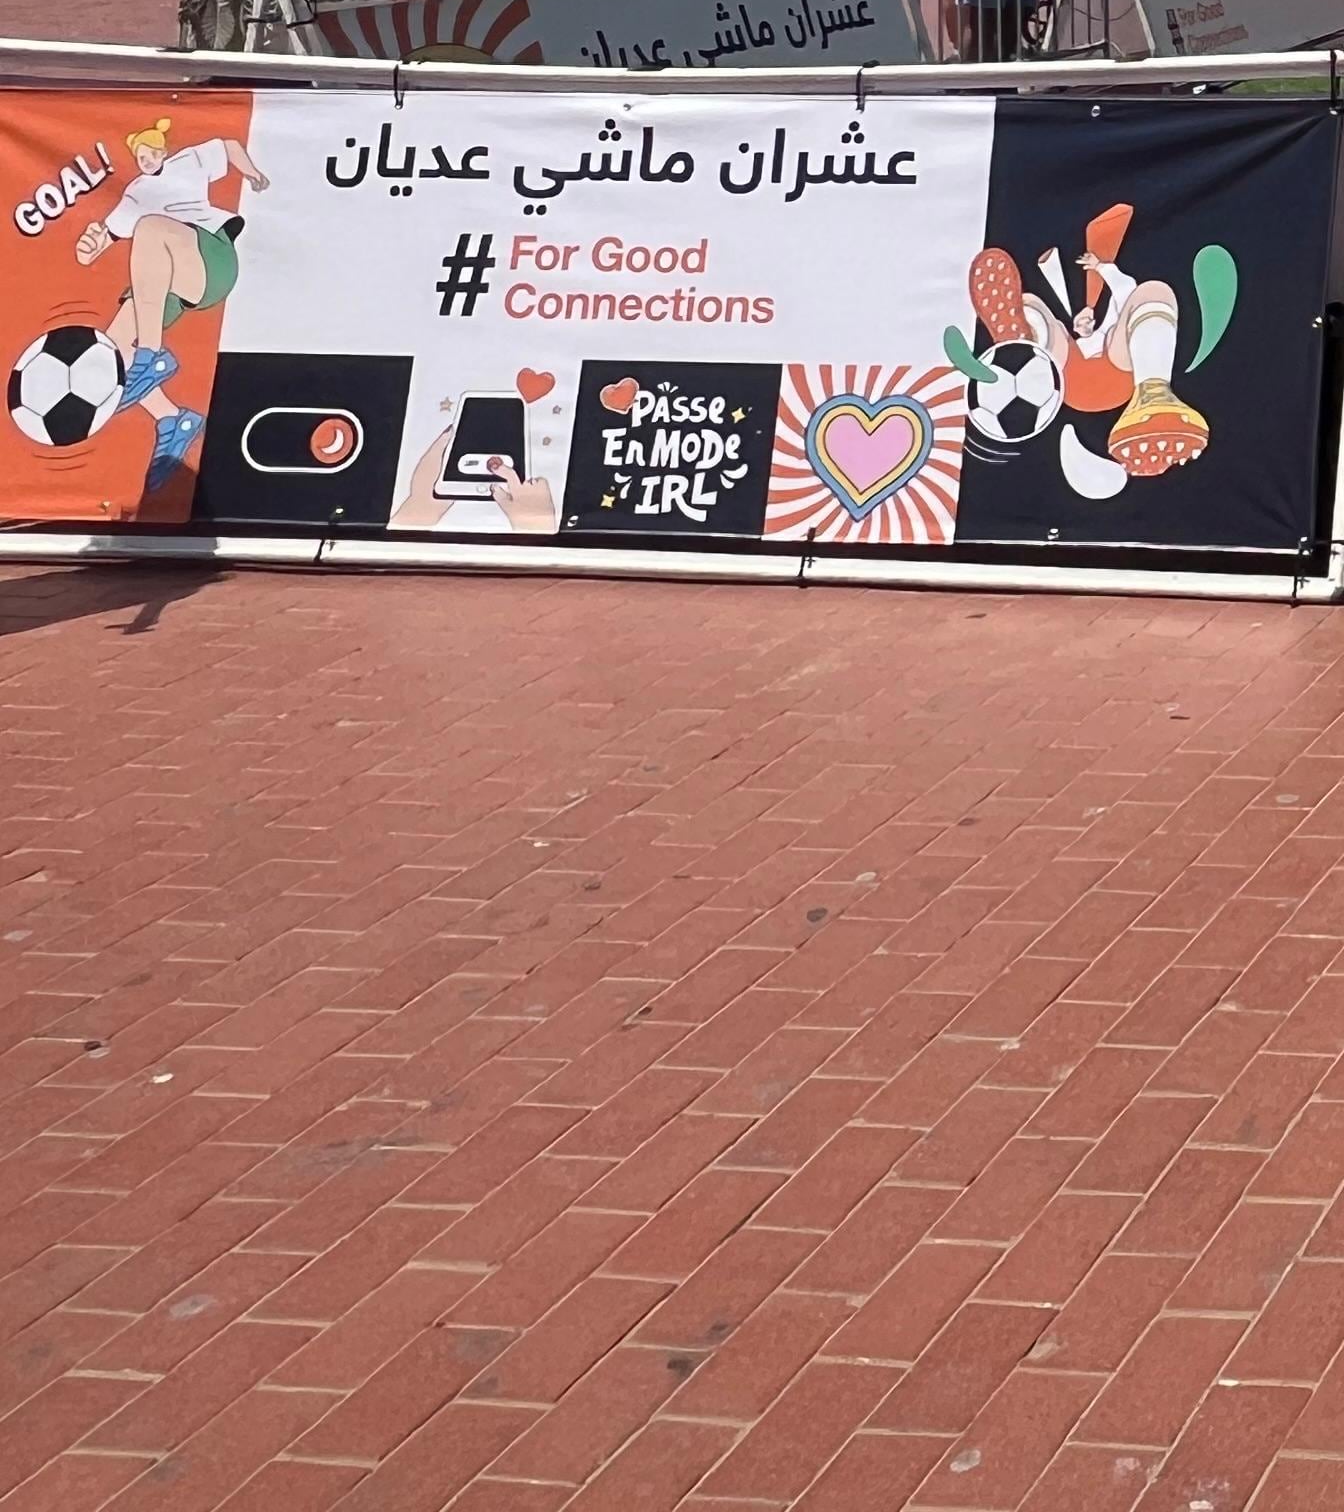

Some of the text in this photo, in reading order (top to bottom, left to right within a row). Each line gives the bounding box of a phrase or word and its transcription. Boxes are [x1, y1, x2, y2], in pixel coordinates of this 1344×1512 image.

[14, 141, 115, 236] GOAL!
[325, 117, 918, 217] عشران ماشي عديان
[436, 233, 709, 317] # For Good
[503, 282, 775, 324] Connections
[602, 427, 646, 467] En
[635, 472, 718, 522] IRL
